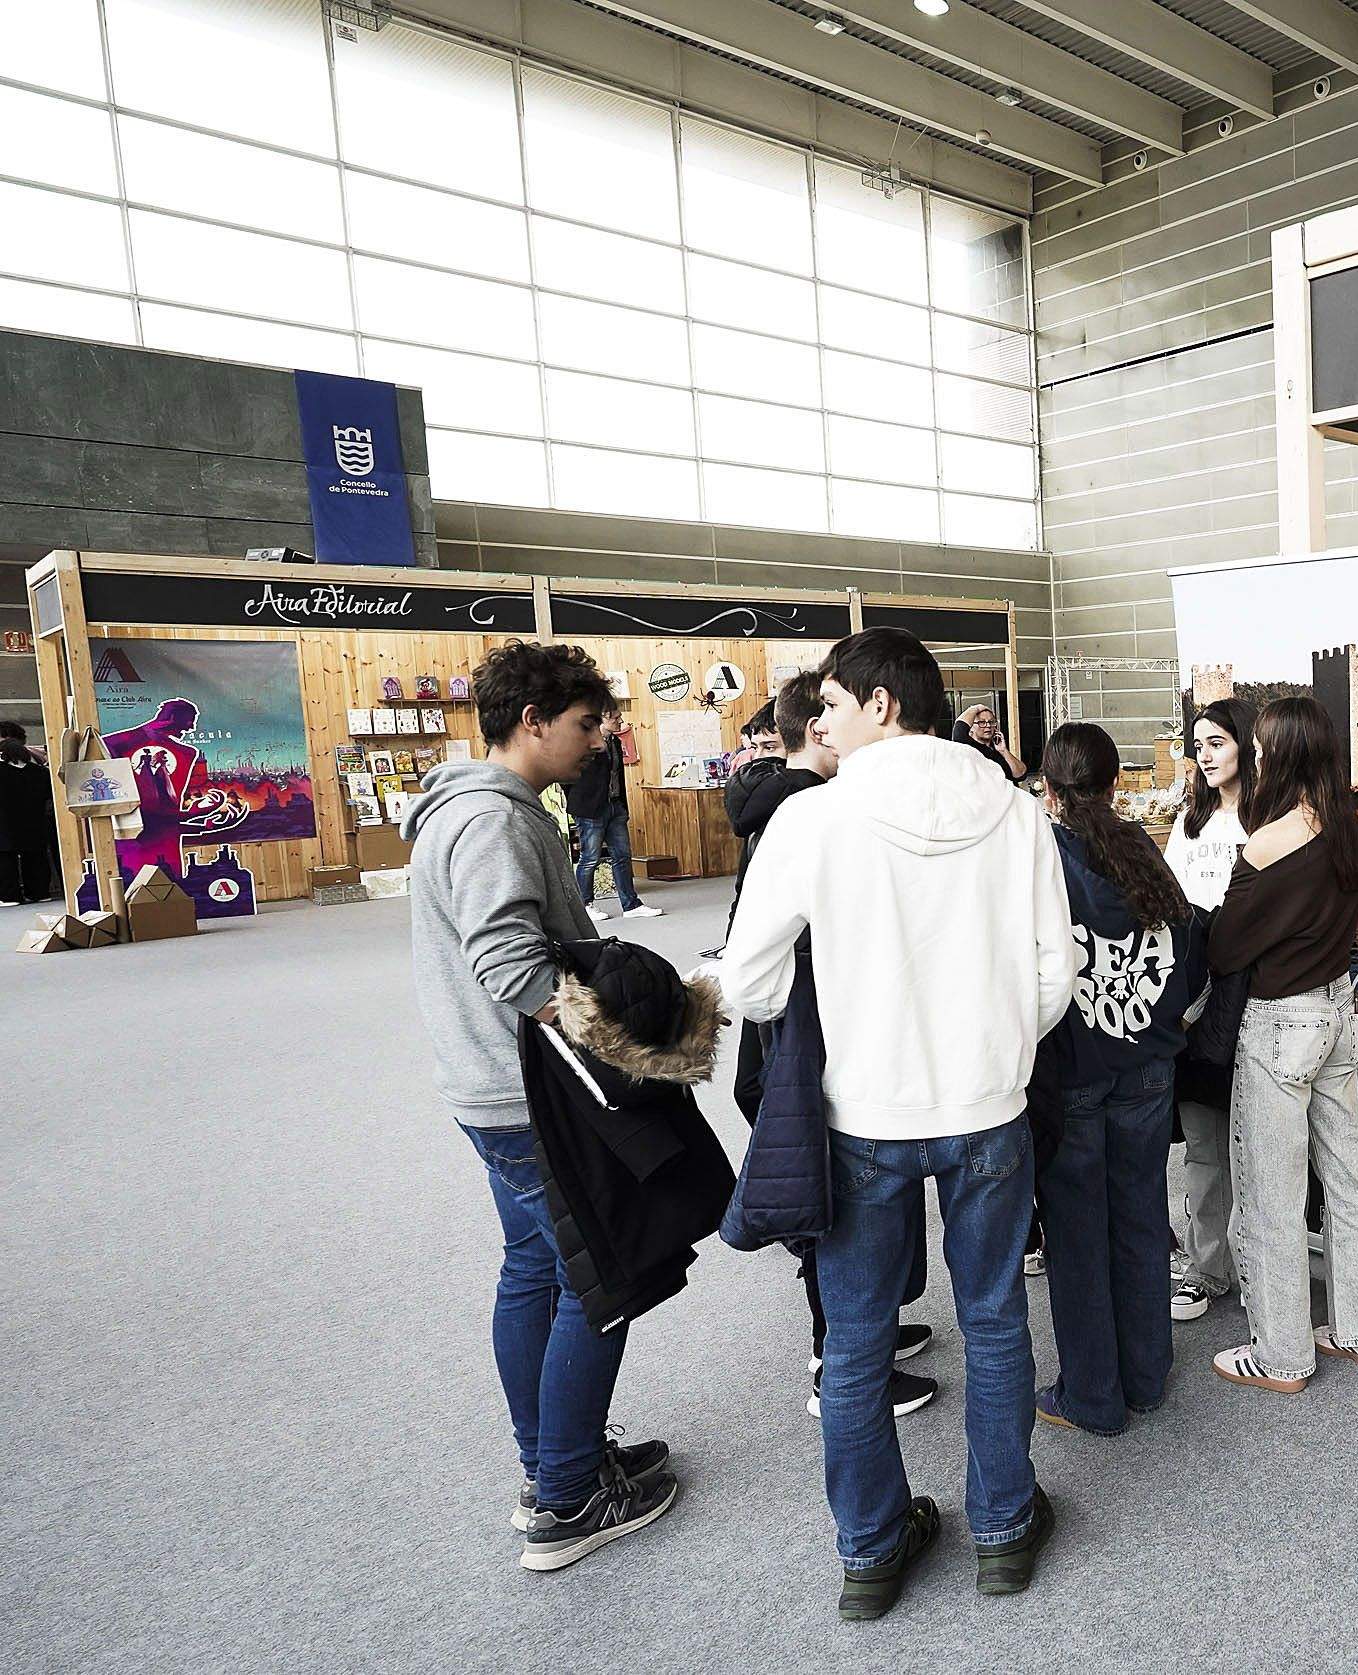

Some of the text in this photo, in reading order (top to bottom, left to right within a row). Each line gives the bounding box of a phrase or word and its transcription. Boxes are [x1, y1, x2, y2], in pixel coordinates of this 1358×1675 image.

[329, 485, 389, 497] de Pontevedra
[340, 479, 377, 489] Concello
[245, 584, 412, 624] Aira Editorial
[650, 675, 689, 692] WOOD MODELS
